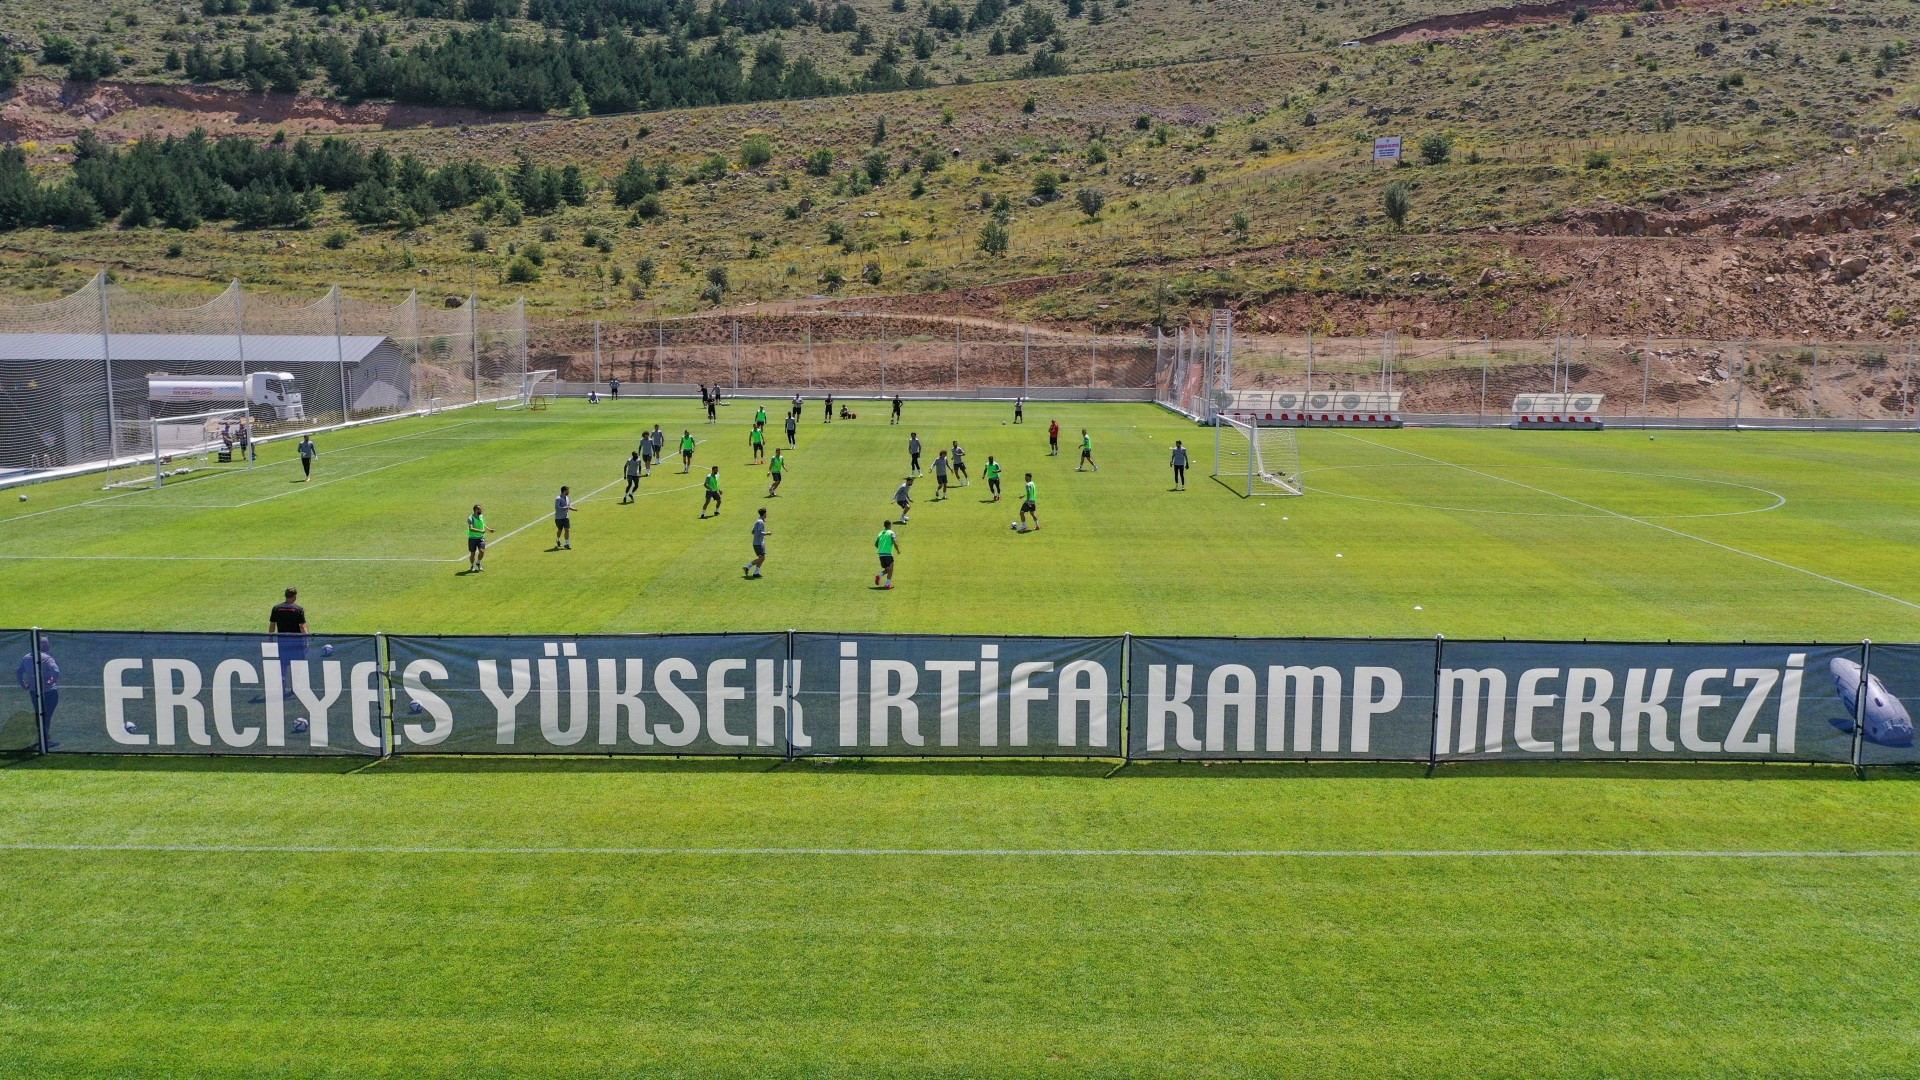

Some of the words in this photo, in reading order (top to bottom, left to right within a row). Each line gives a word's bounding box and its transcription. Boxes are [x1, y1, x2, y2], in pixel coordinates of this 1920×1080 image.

[103, 642, 453, 748] ERCİYES
[478, 642, 812, 747] YÜKSEK
[839, 642, 1108, 747] İRTİFA
[1146, 663, 1403, 753] KAMP
[1435, 653, 1807, 755] MERKEZİ
